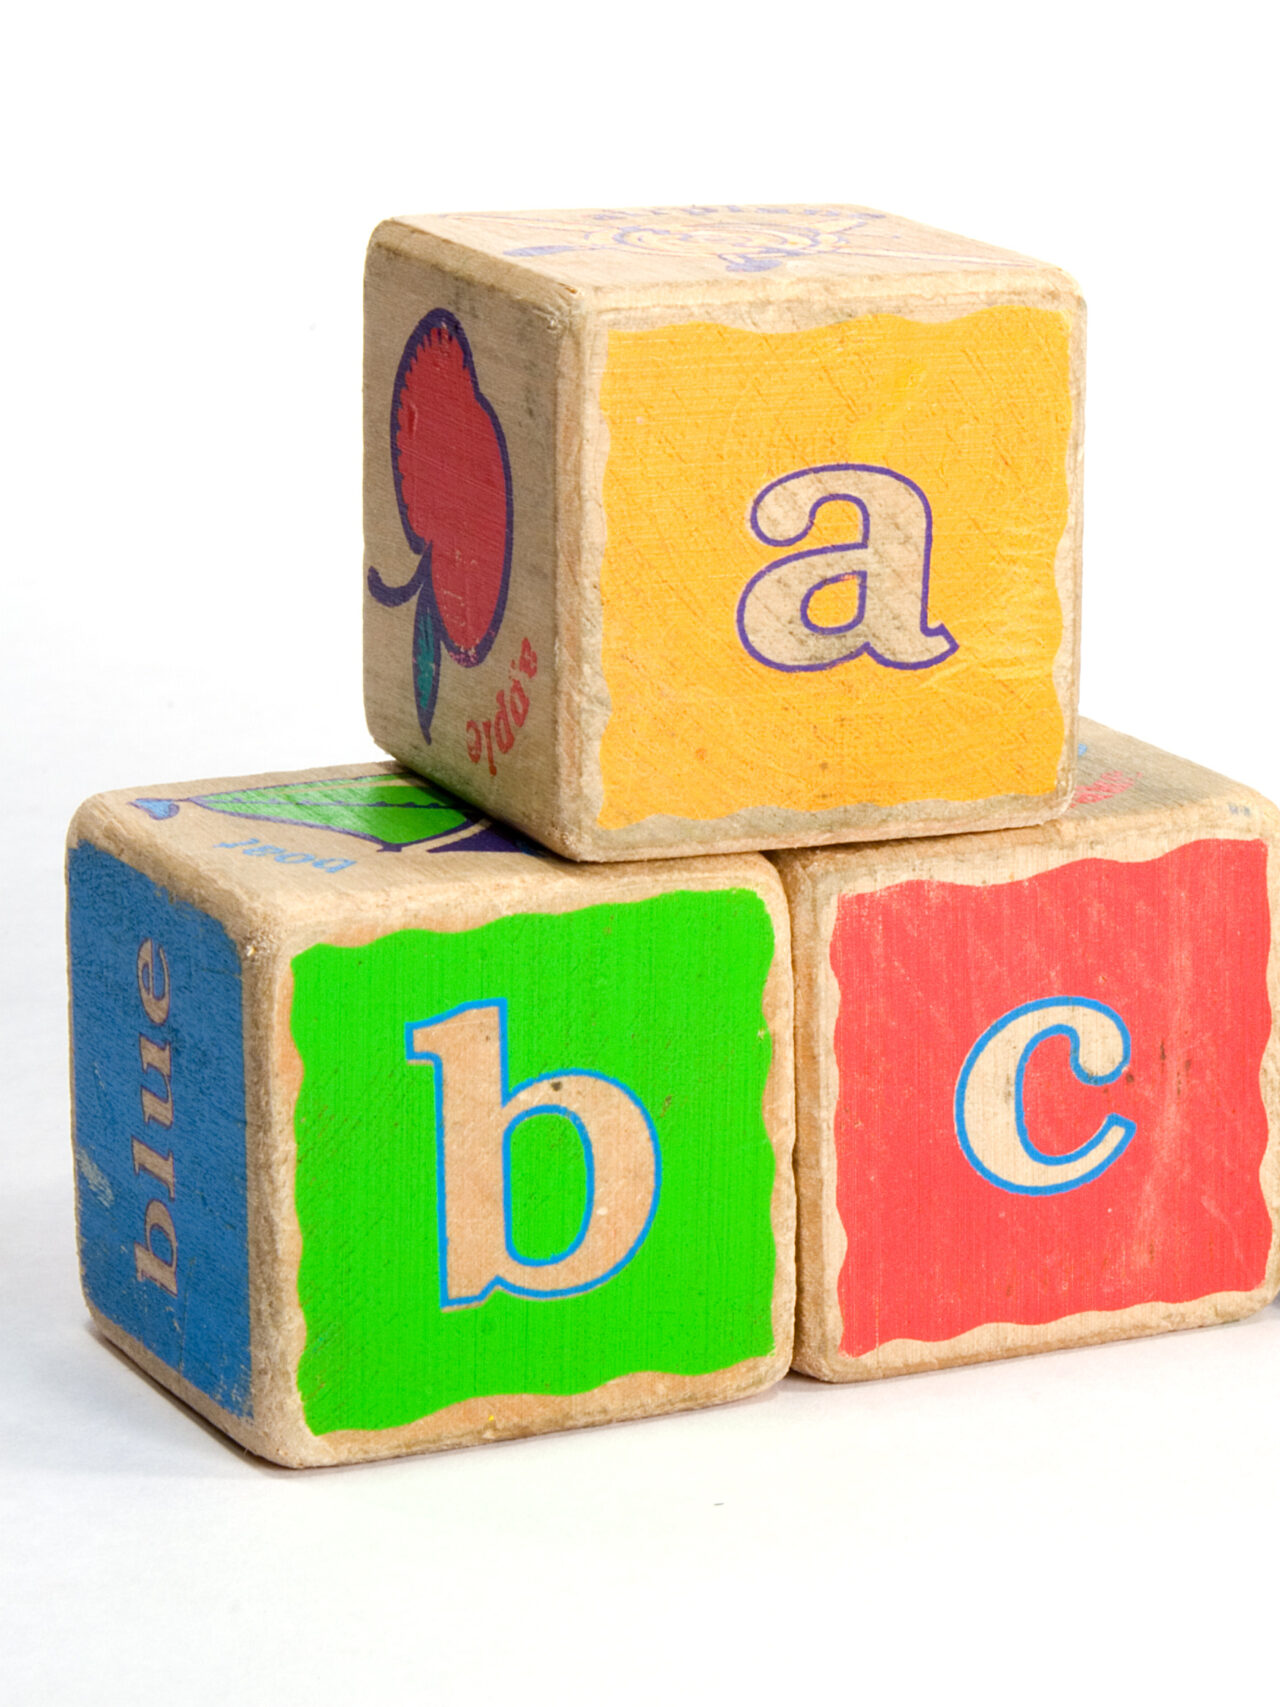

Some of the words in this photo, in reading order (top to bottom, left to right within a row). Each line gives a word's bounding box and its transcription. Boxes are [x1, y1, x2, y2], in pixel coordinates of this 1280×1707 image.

[736, 463, 960, 672] a
[212, 837, 358, 874] boat
[130, 937, 178, 1296] blue
[404, 997, 662, 1312] b
[953, 995, 1137, 1197] c
